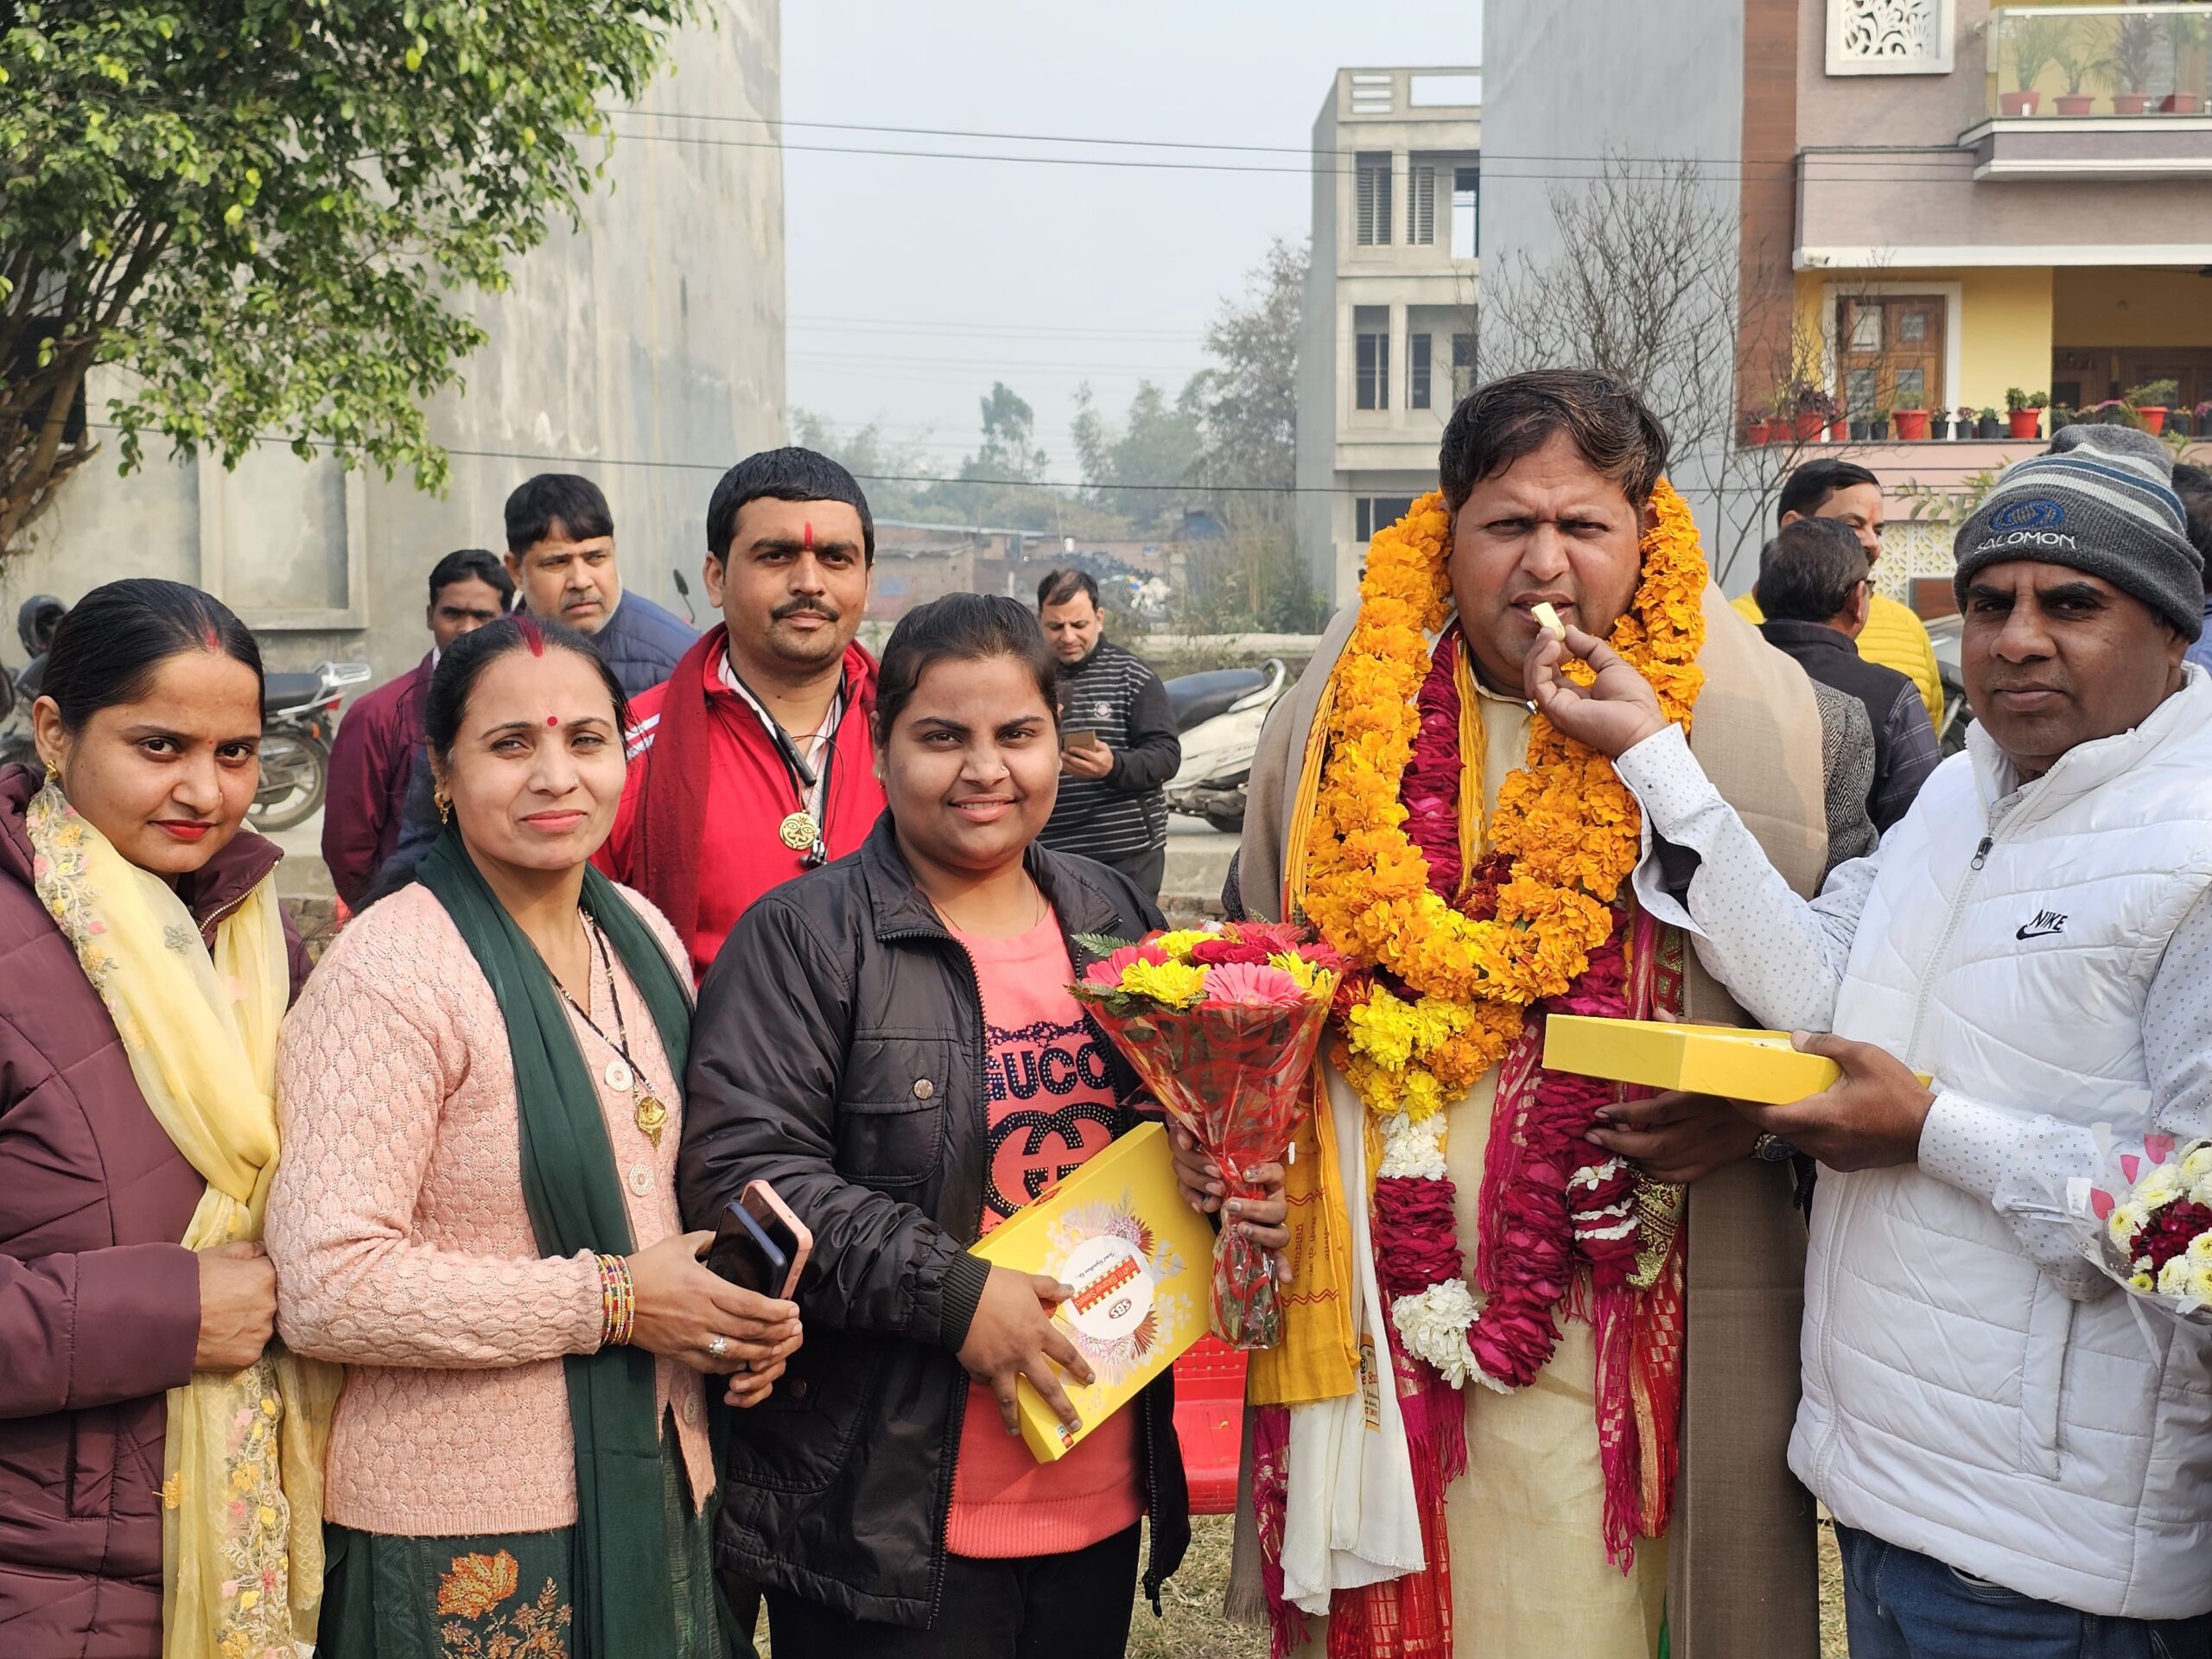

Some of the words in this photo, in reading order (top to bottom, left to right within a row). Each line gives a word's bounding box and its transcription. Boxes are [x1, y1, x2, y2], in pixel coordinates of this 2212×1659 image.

[1974, 531, 2075, 555] SALOMON
[2029, 909, 2069, 931] NIKE
[985, 1042, 1113, 1101] GUCC
[1109, 1299, 1132, 1319] SBS
